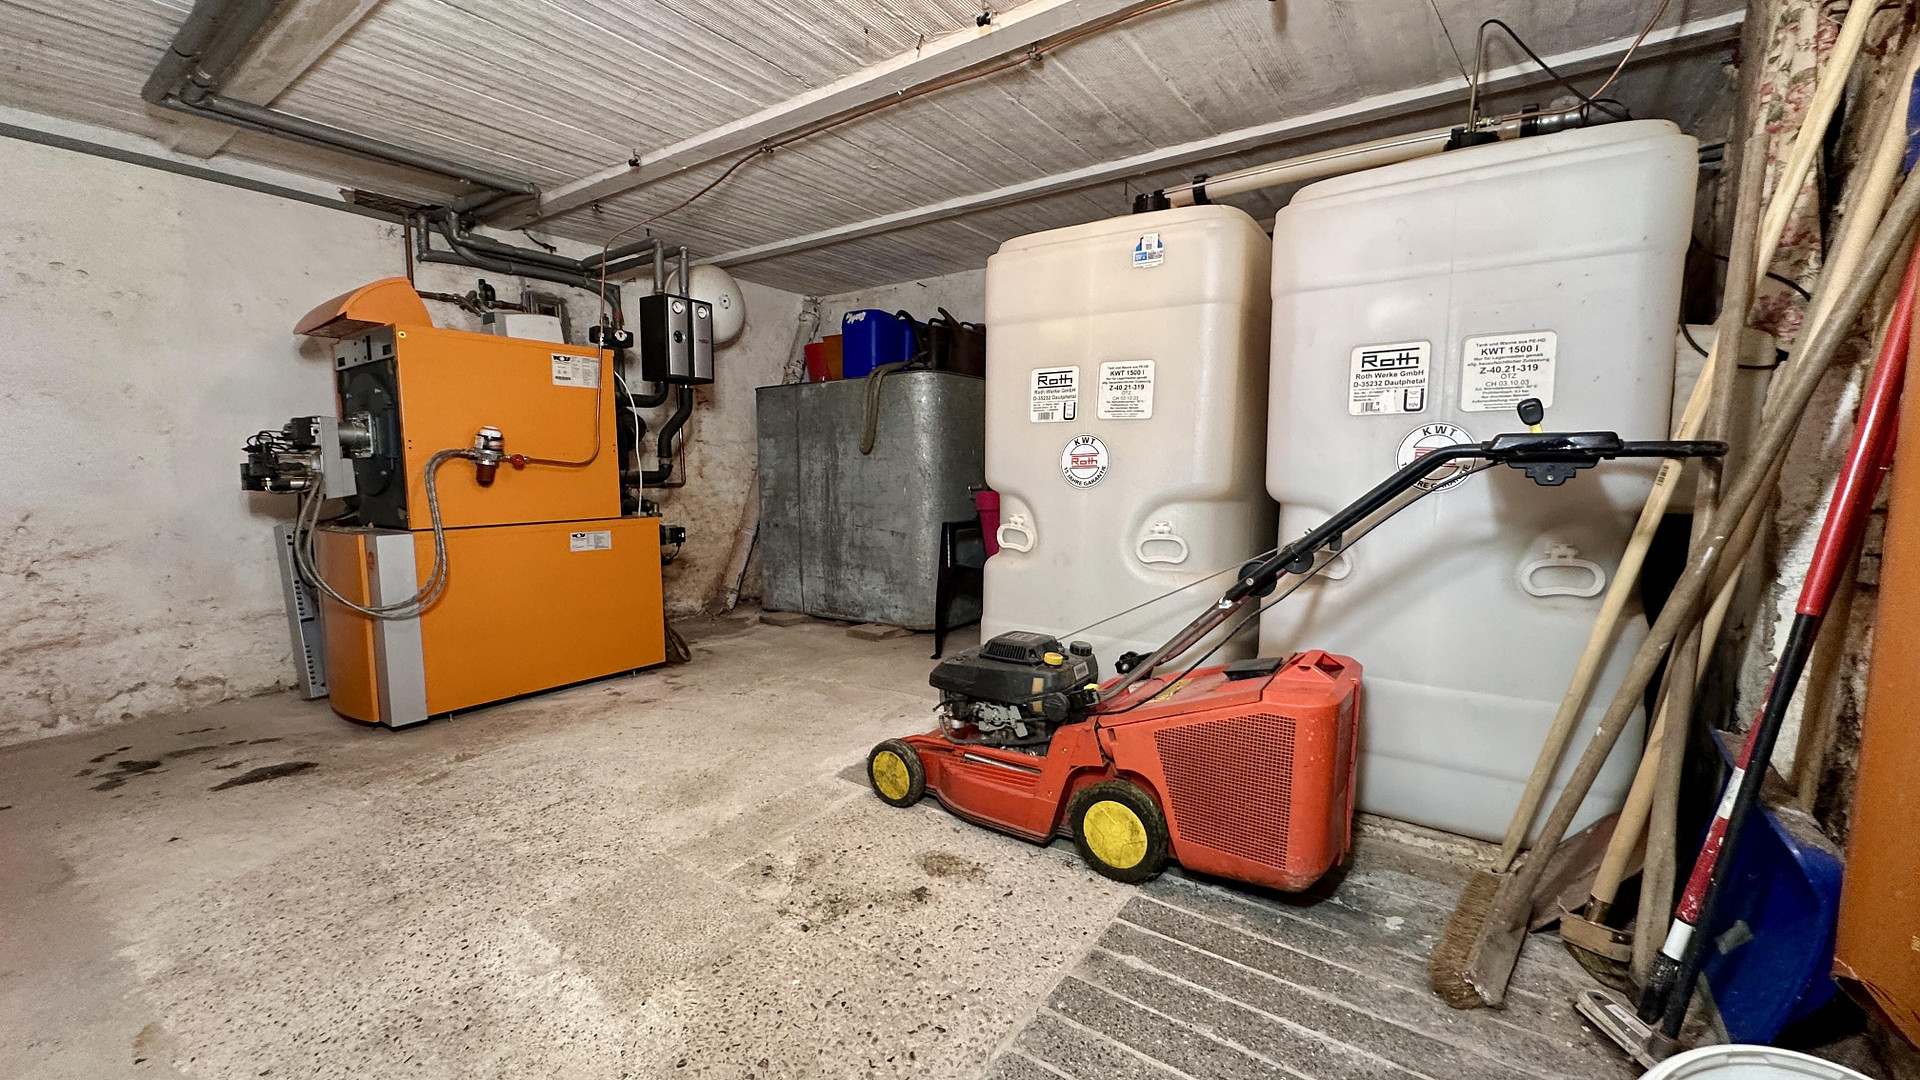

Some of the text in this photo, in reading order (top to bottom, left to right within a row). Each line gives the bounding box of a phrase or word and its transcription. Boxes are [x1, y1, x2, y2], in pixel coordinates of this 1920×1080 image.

[1481, 347, 1505, 355] KWT
[1509, 345, 1533, 353] 1500
[1361, 352, 1419, 368] Roth
[1479, 363, 1539, 374] Z-40.21-319
[1038, 374, 1072, 386] Roth
[1422, 426, 1458, 436] KWT
[1074, 436, 1095, 446] KWT
[1071, 457, 1098, 465] Roth
[1067, 474, 1082, 485] JAHRE
[1084, 466, 1106, 486] GARANTIE
